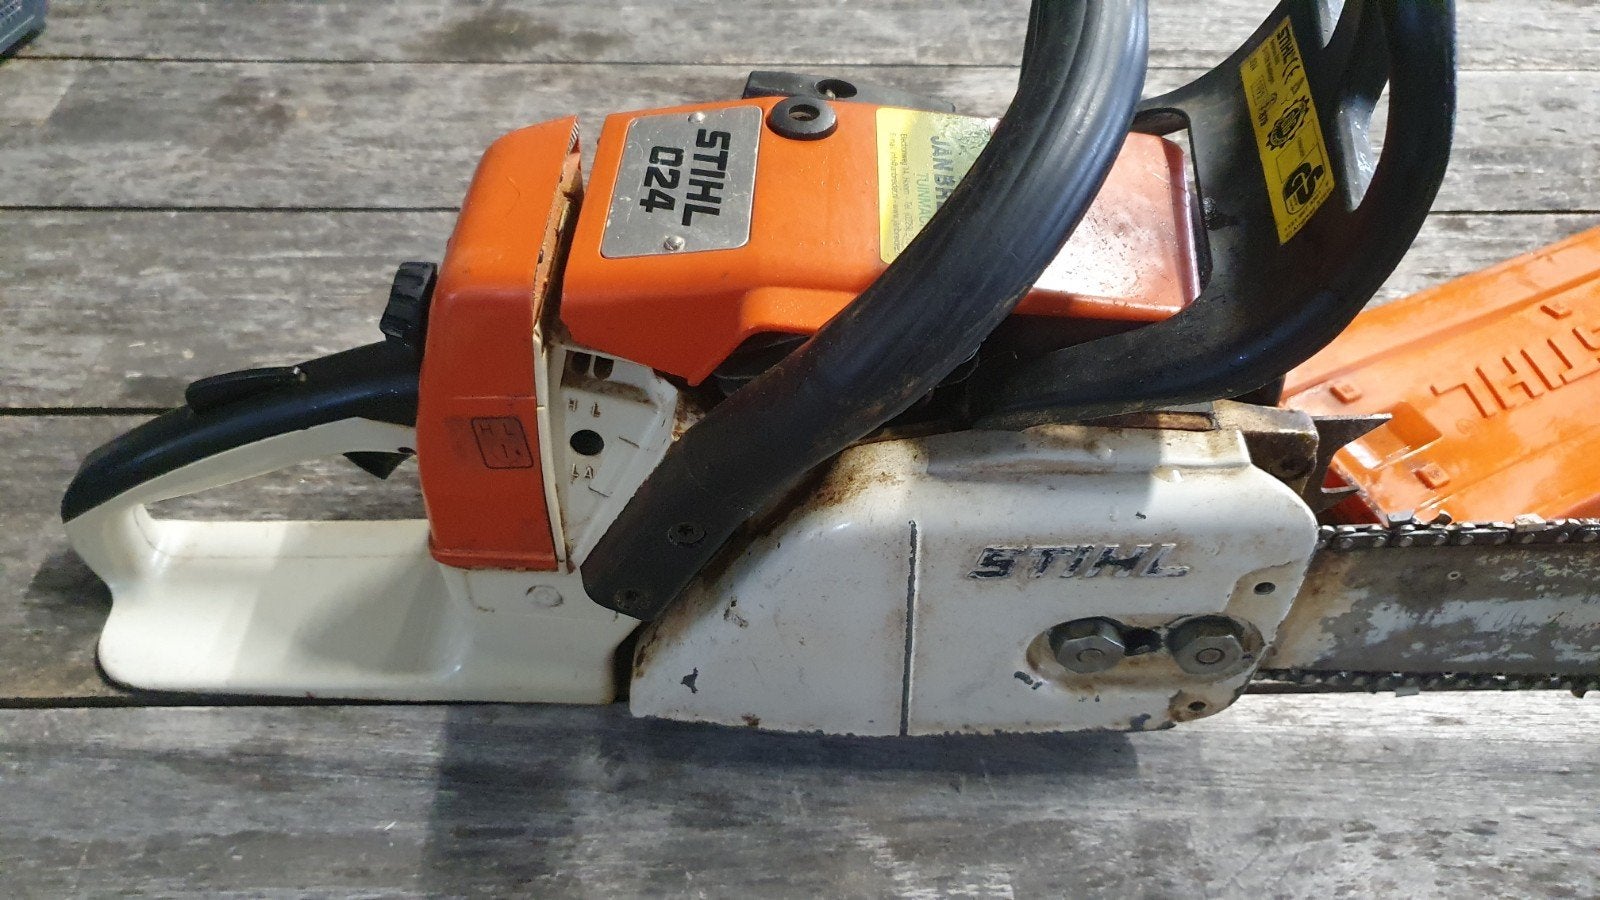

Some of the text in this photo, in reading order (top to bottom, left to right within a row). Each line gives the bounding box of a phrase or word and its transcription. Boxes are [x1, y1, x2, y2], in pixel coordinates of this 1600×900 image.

[1277, 25, 1297, 64] STIHL
[639, 144, 685, 213] 024
[682, 128, 731, 227] STIHL
[930, 136, 954, 175] JAN
[916, 173, 931, 226] TUINMAC
[966, 543, 1191, 579] STIHL
